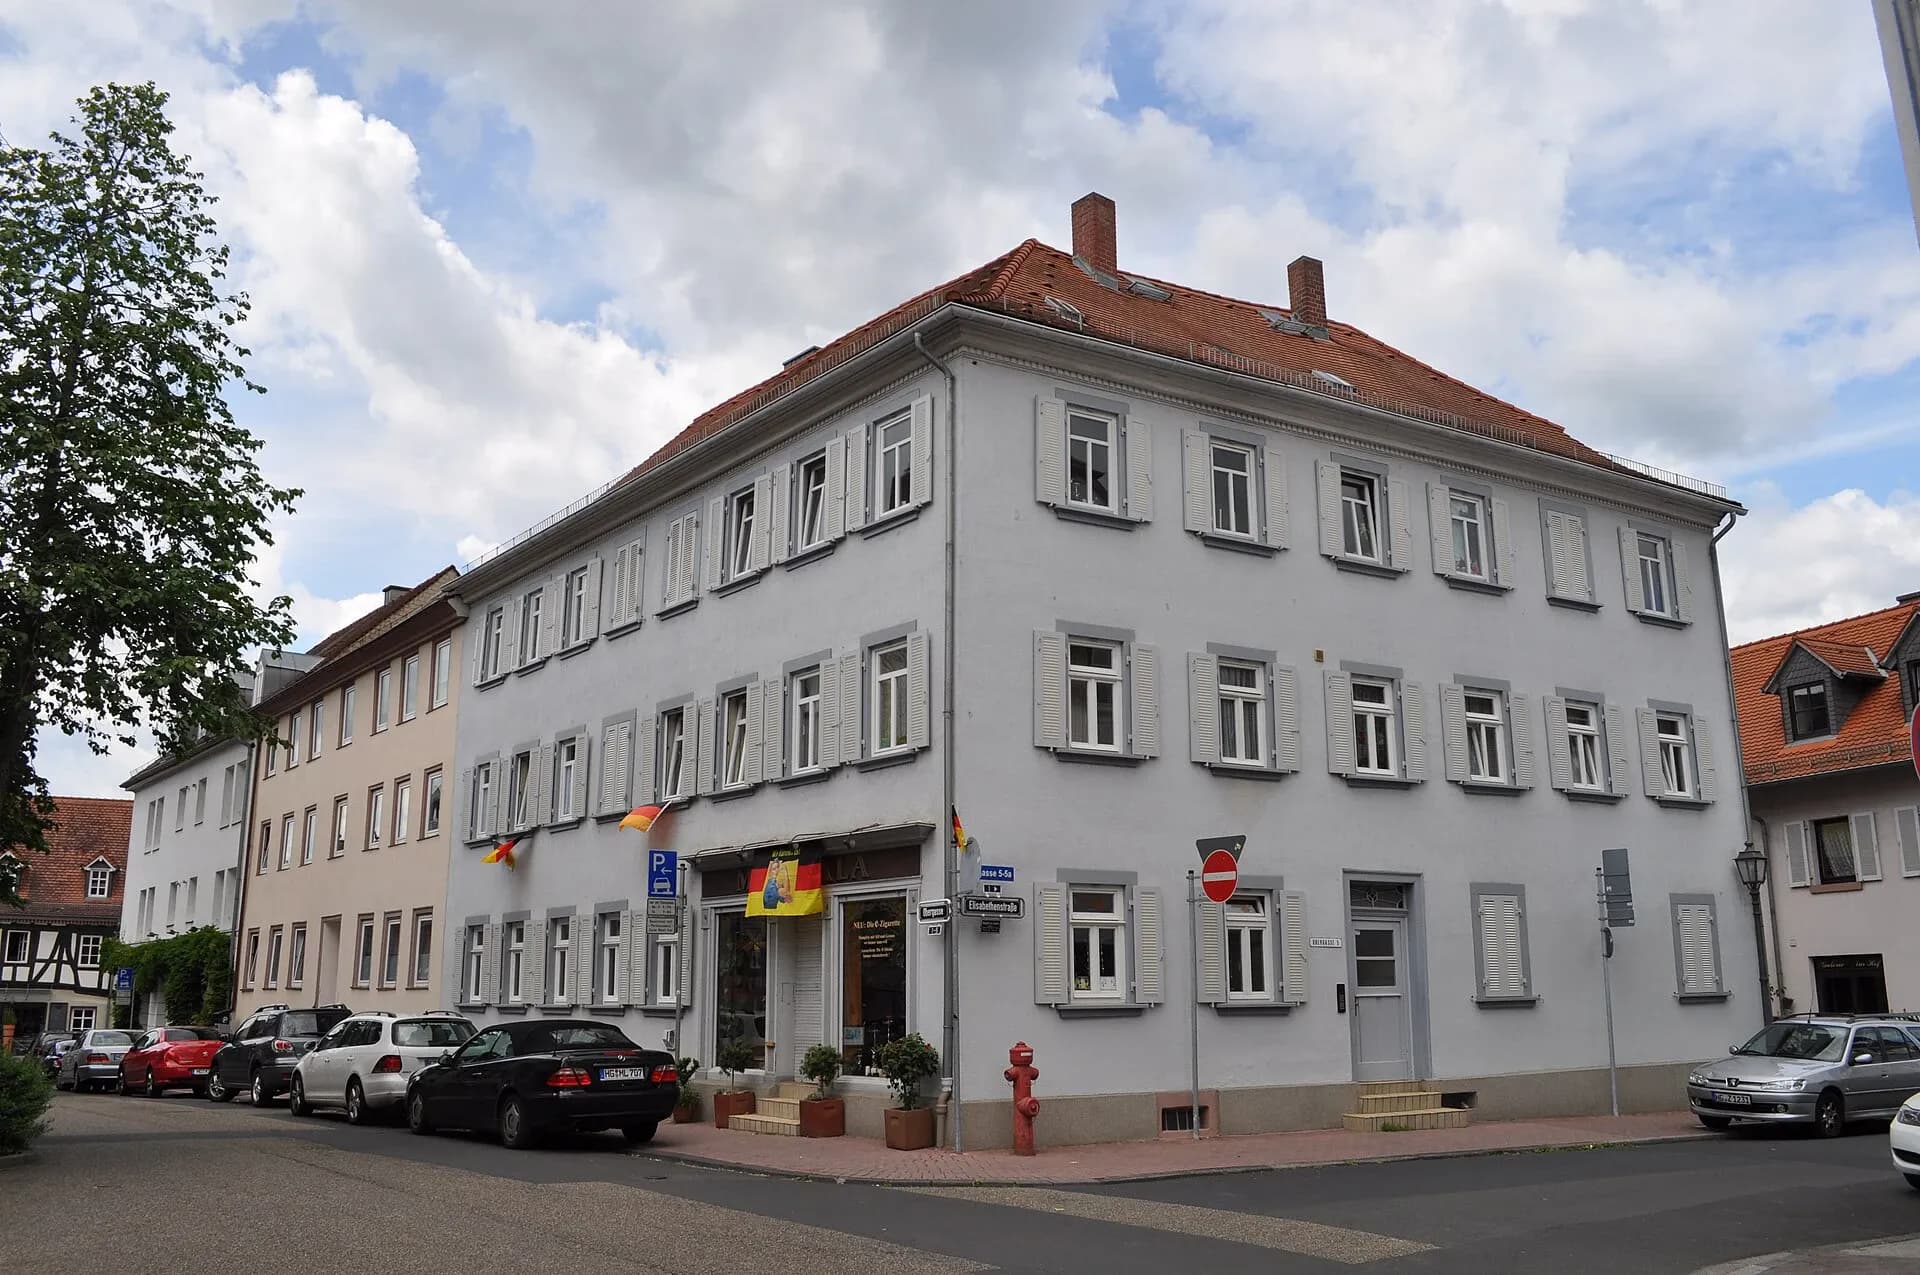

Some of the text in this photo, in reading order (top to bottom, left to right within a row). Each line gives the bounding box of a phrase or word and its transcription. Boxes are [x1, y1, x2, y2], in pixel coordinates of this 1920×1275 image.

[653, 853, 666, 872] P
[981, 869, 1012, 878] asse 5-5a
[968, 900, 1018, 913] Elisabethenstraße
[120, 969, 127, 977] P
[604, 1069, 615, 1078] HG
[629, 1069, 642, 1077] 707
